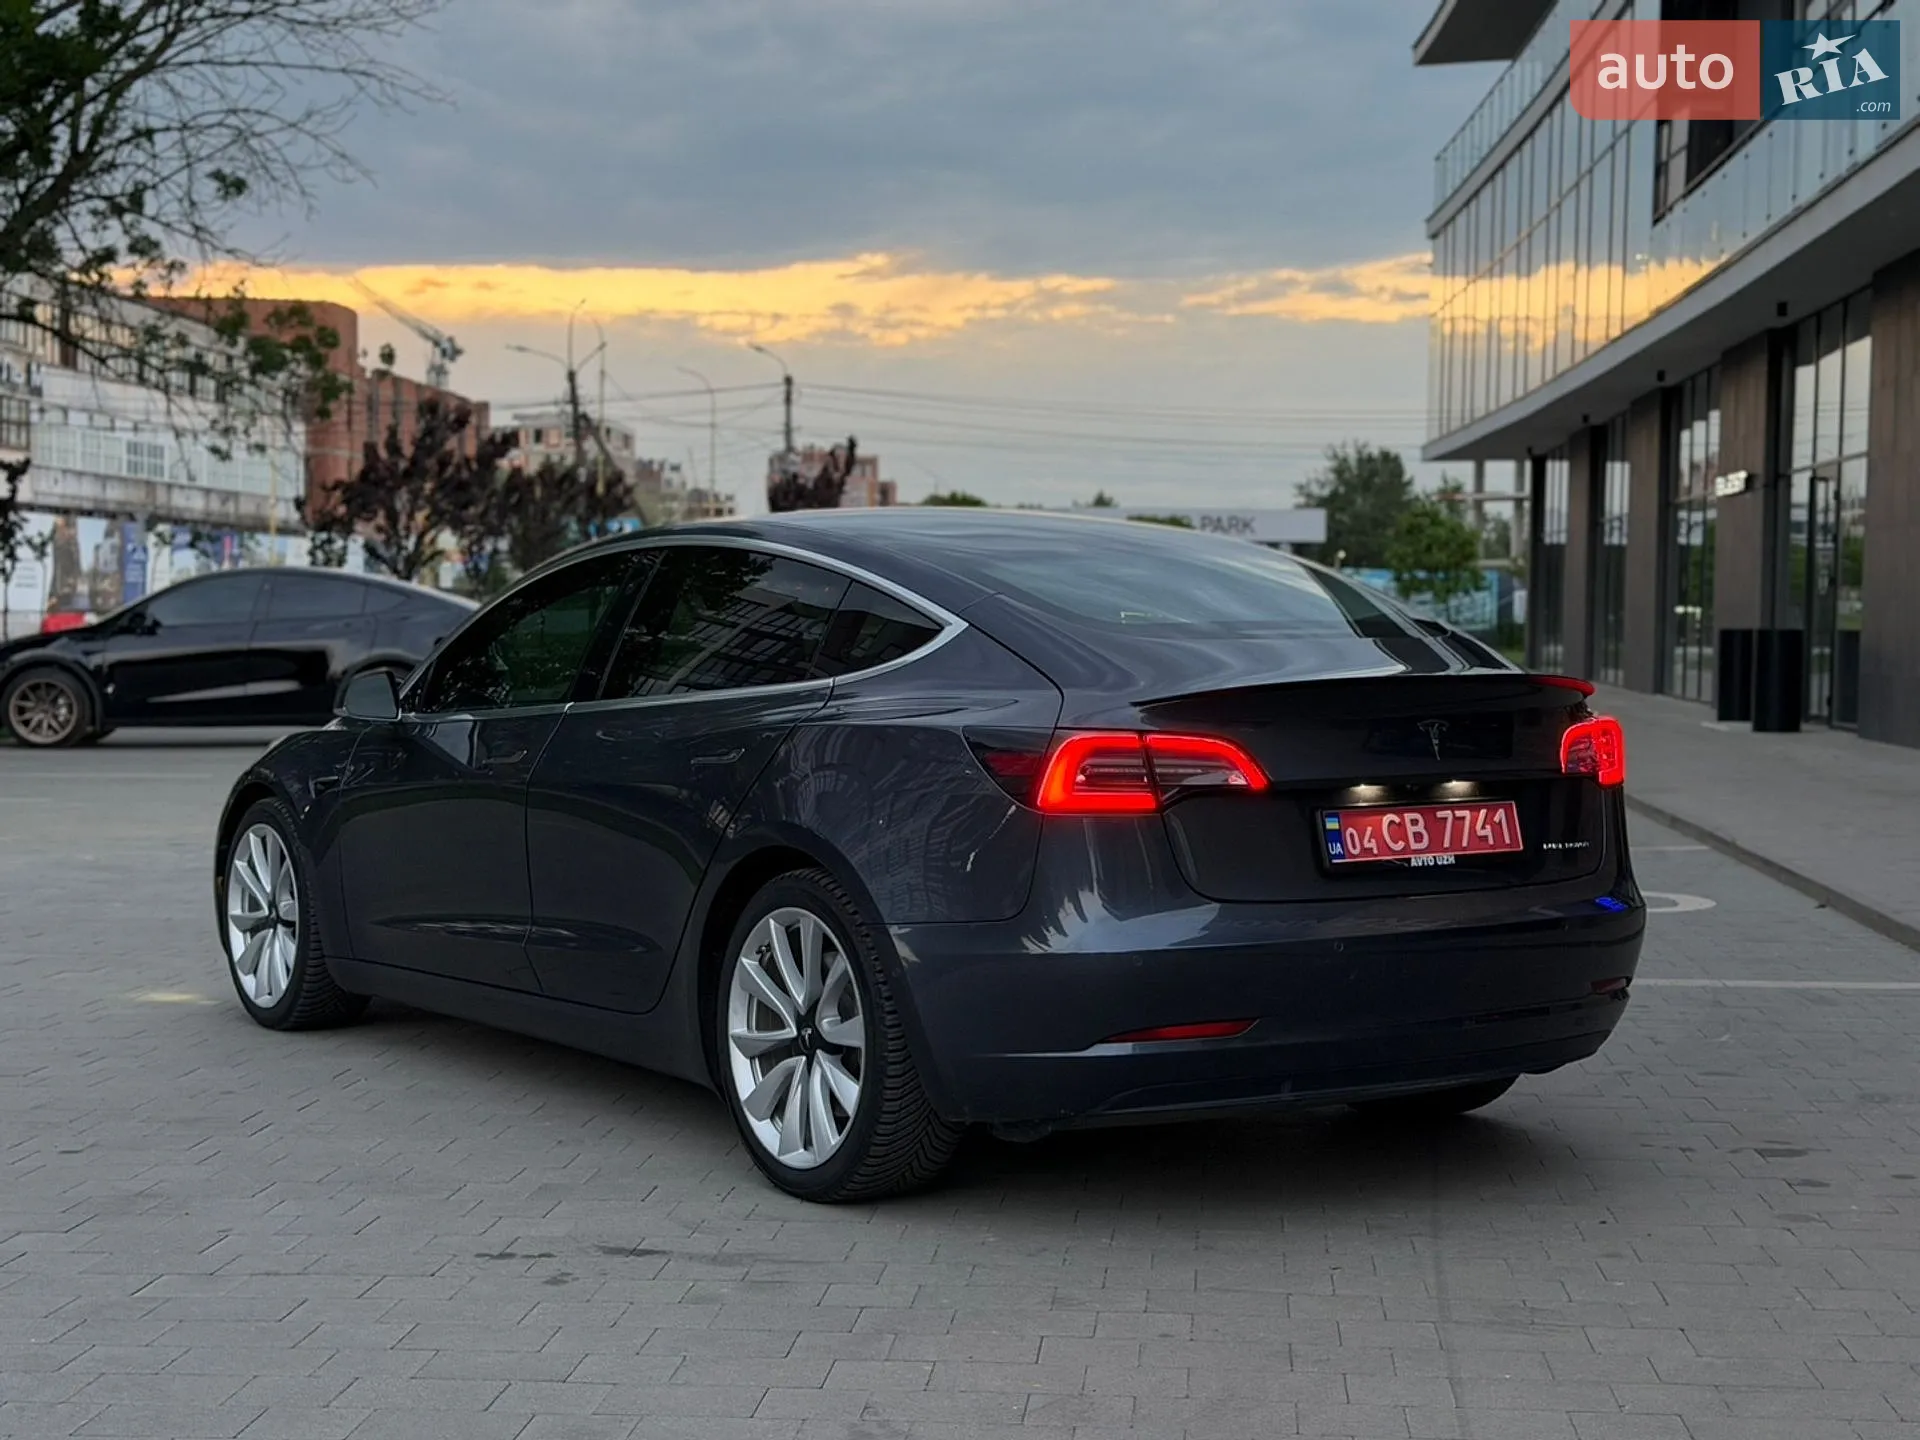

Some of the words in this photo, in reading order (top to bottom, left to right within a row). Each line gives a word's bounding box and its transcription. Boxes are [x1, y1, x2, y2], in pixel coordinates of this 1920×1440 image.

[1200, 516, 1255, 534] PARK
[1345, 826, 1378, 856] 04
[1382, 812, 1429, 851] CB
[1436, 808, 1511, 848] 7741
[1328, 842, 1343, 855] UA
[1410, 856, 1435, 867] AVTO
